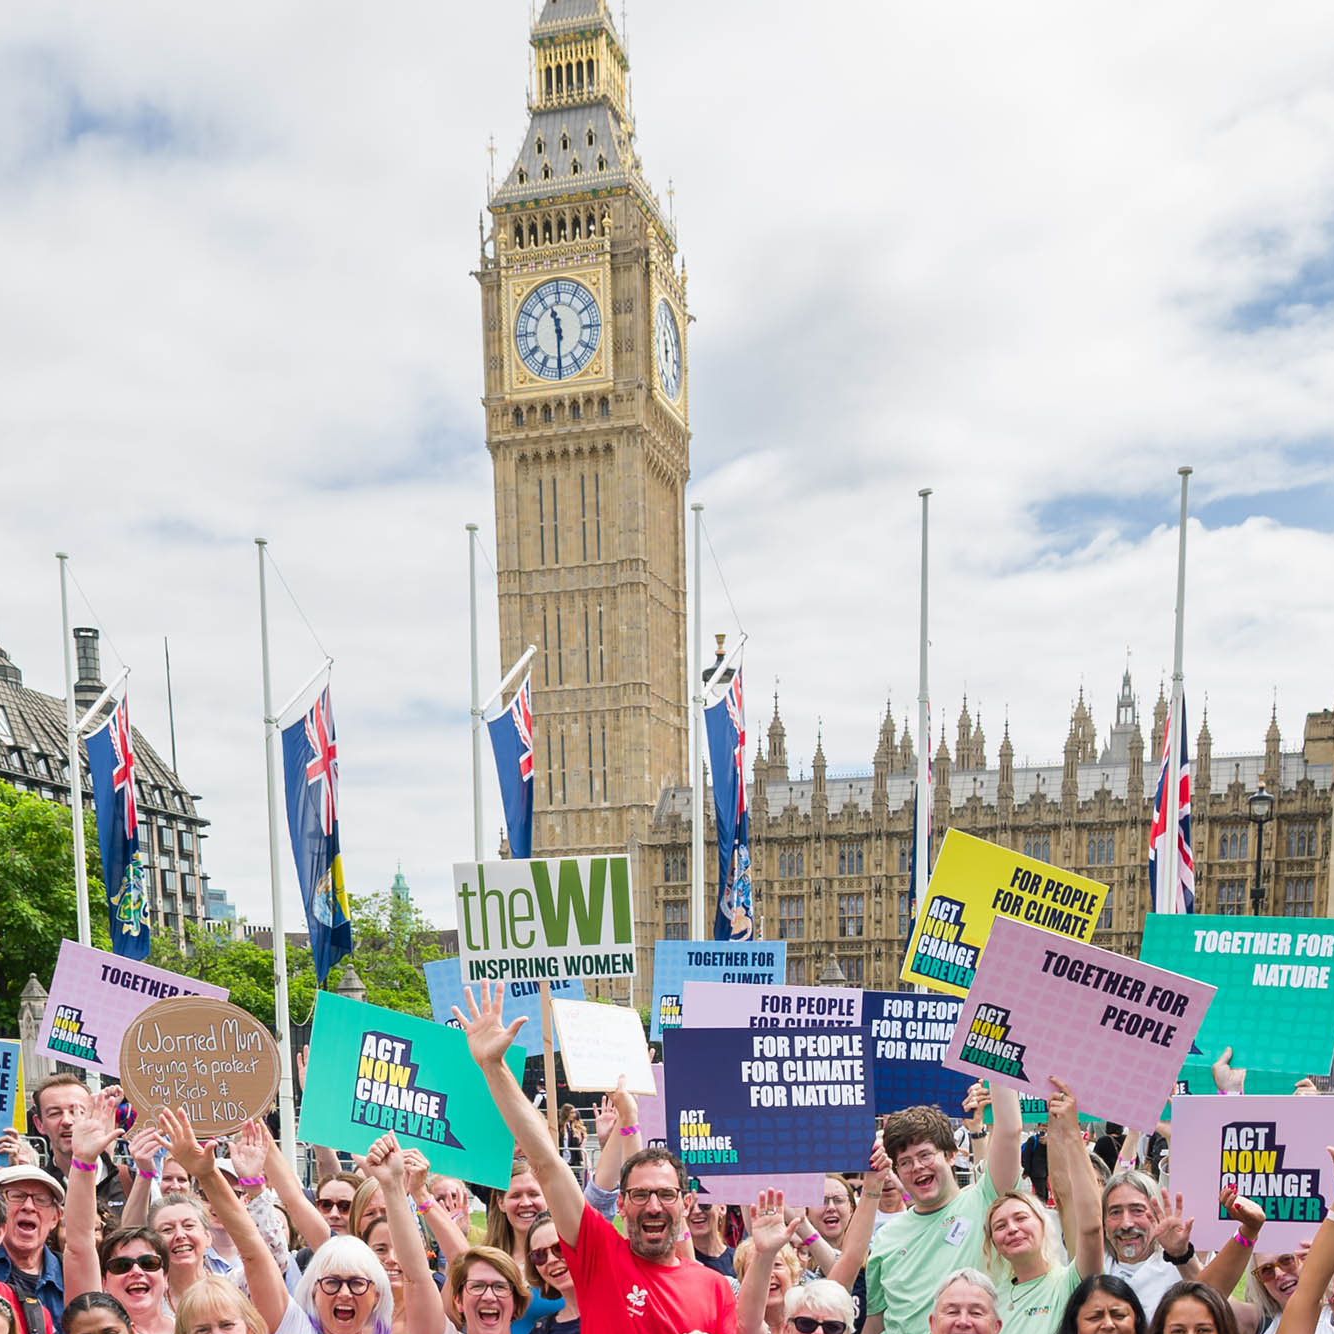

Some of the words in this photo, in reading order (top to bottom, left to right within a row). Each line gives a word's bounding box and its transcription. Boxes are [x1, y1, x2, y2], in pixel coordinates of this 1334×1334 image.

[1010, 867, 1042, 894] FOR
[1042, 879, 1099, 915] PEOPLE
[928, 900, 960, 921] ACT
[992, 889, 1024, 916] FOR
[1024, 900, 1090, 940] CLIMATE
[923, 917, 959, 943] NOW
[917, 936, 975, 968] CHANGE
[1194, 931, 1290, 956] TOGETHER
[1295, 934, 1334, 956] FOR
[469, 956, 559, 981] INSPIRING
[564, 953, 633, 976] WOMEN
[688, 952, 748, 966] TOGETHER
[751, 952, 774, 966] FOR
[101, 965, 179, 998] TOGETHER
[1041, 951, 1146, 1004] TOGETHER
[1144, 983, 1189, 1017] FOR
[1252, 964, 1329, 988] NATURE
[661, 998, 677, 1006] ACT
[661, 1006, 680, 1015] NOW
[761, 996, 788, 1013] FOR
[796, 996, 854, 1016] PEOPLE
[54, 1016, 81, 1034] NOW
[56, 1007, 81, 1022] ACT
[976, 1006, 1005, 1025] ACT
[51, 1027, 96, 1047] CHANGE
[137, 1023, 217, 1052] Worried
[222, 1019, 262, 1052] Mum
[971, 1020, 1005, 1041] NOW
[1099, 1005, 1177, 1048] PEOPLE
[48, 1037, 96, 1060] FOREVER
[362, 1036, 405, 1065] ACT
[754, 1037, 789, 1057] FOR
[795, 1035, 863, 1056] PEOPLE
[967, 1034, 1021, 1062] CHANGE
[137, 1056, 188, 1083] trying
[192, 1056, 207, 1075] to
[211, 1054, 259, 1083] protect
[358, 1056, 411, 1088] NOW
[742, 1062, 778, 1082] FOR
[783, 1060, 864, 1081] CLIMATE
[961, 1048, 1023, 1076] FOREVER
[150, 1083, 171, 1104] my
[175, 1079, 208, 1099] Kids
[355, 1078, 440, 1118] CHANGE
[750, 1086, 786, 1107] FOR
[792, 1084, 865, 1105] NATURE
[180, 1102, 207, 1121] ALL
[212, 1101, 247, 1123] KIDS
[352, 1101, 446, 1142] FOREVER
[680, 1110, 705, 1124] ACT
[680, 1123, 710, 1137] NOW
[680, 1137, 731, 1150] CHANGE
[680, 1150, 738, 1163] FOREVER
